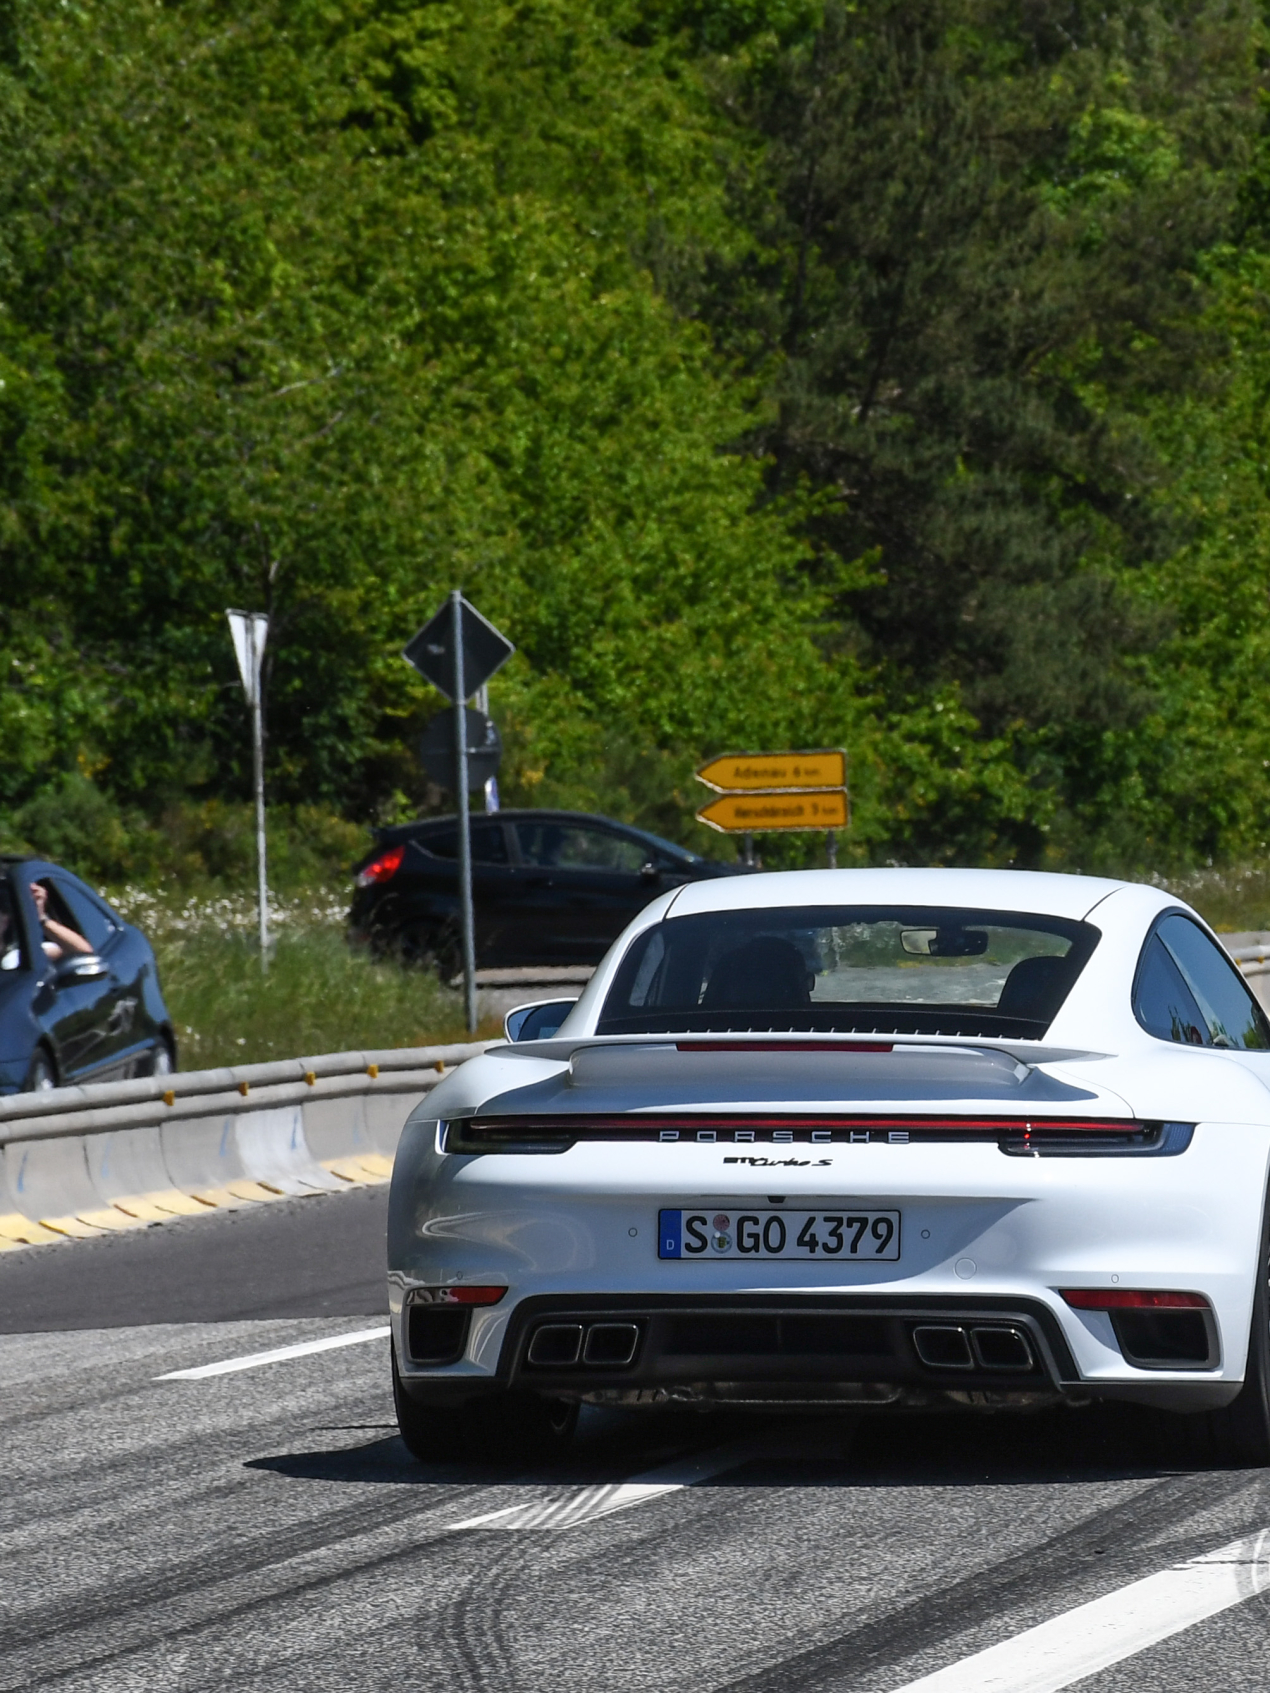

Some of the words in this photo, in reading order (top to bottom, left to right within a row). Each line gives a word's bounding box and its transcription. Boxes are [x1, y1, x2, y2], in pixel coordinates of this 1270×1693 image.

[659, 1130, 910, 1144] PORSCHE
[684, 1215, 708, 1254] S
[736, 1215, 787, 1254] GO
[796, 1215, 894, 1254] 4379
